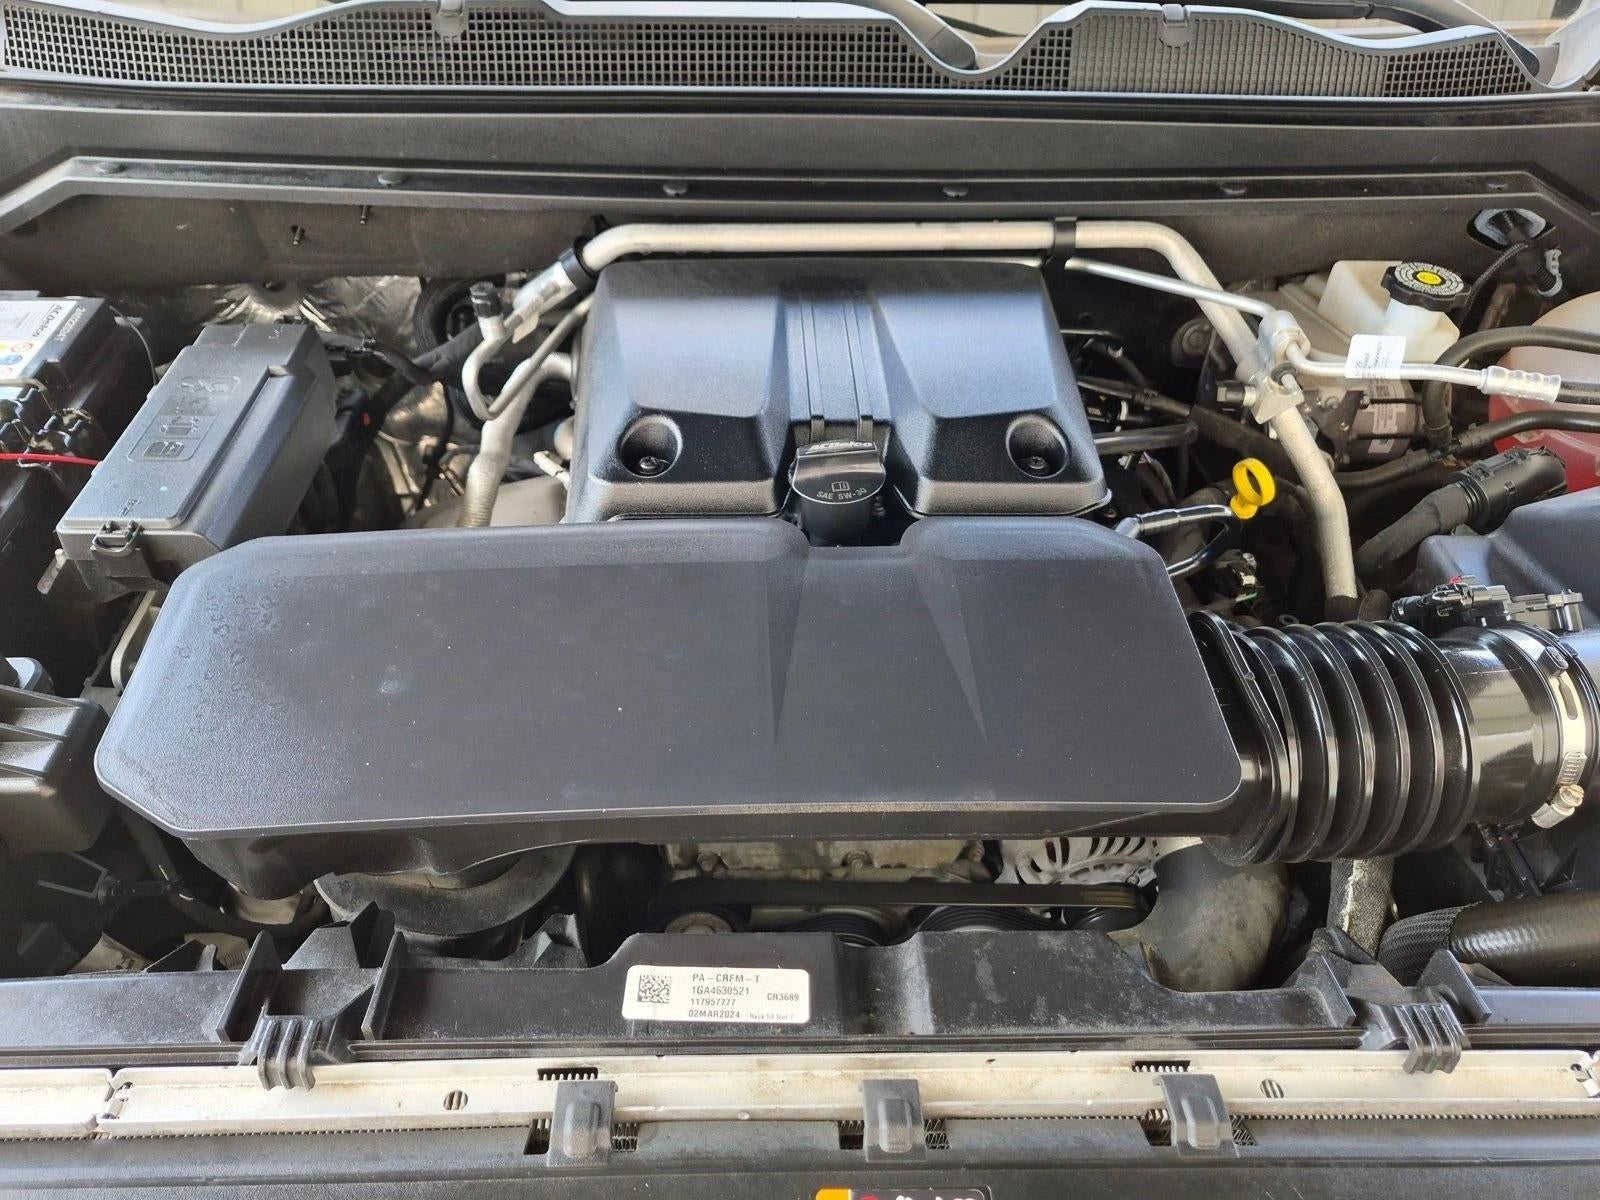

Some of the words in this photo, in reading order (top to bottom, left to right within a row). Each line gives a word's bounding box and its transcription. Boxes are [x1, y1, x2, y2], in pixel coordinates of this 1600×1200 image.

[816, 491, 834, 500] SAE
[838, 488, 867, 500] 5W-30
[692, 985, 750, 995] 1GA4630521
[690, 998, 736, 1006] 117957777
[766, 992, 800, 1002] CR3689
[688, 1009, 741, 1019] 02MAR2024
